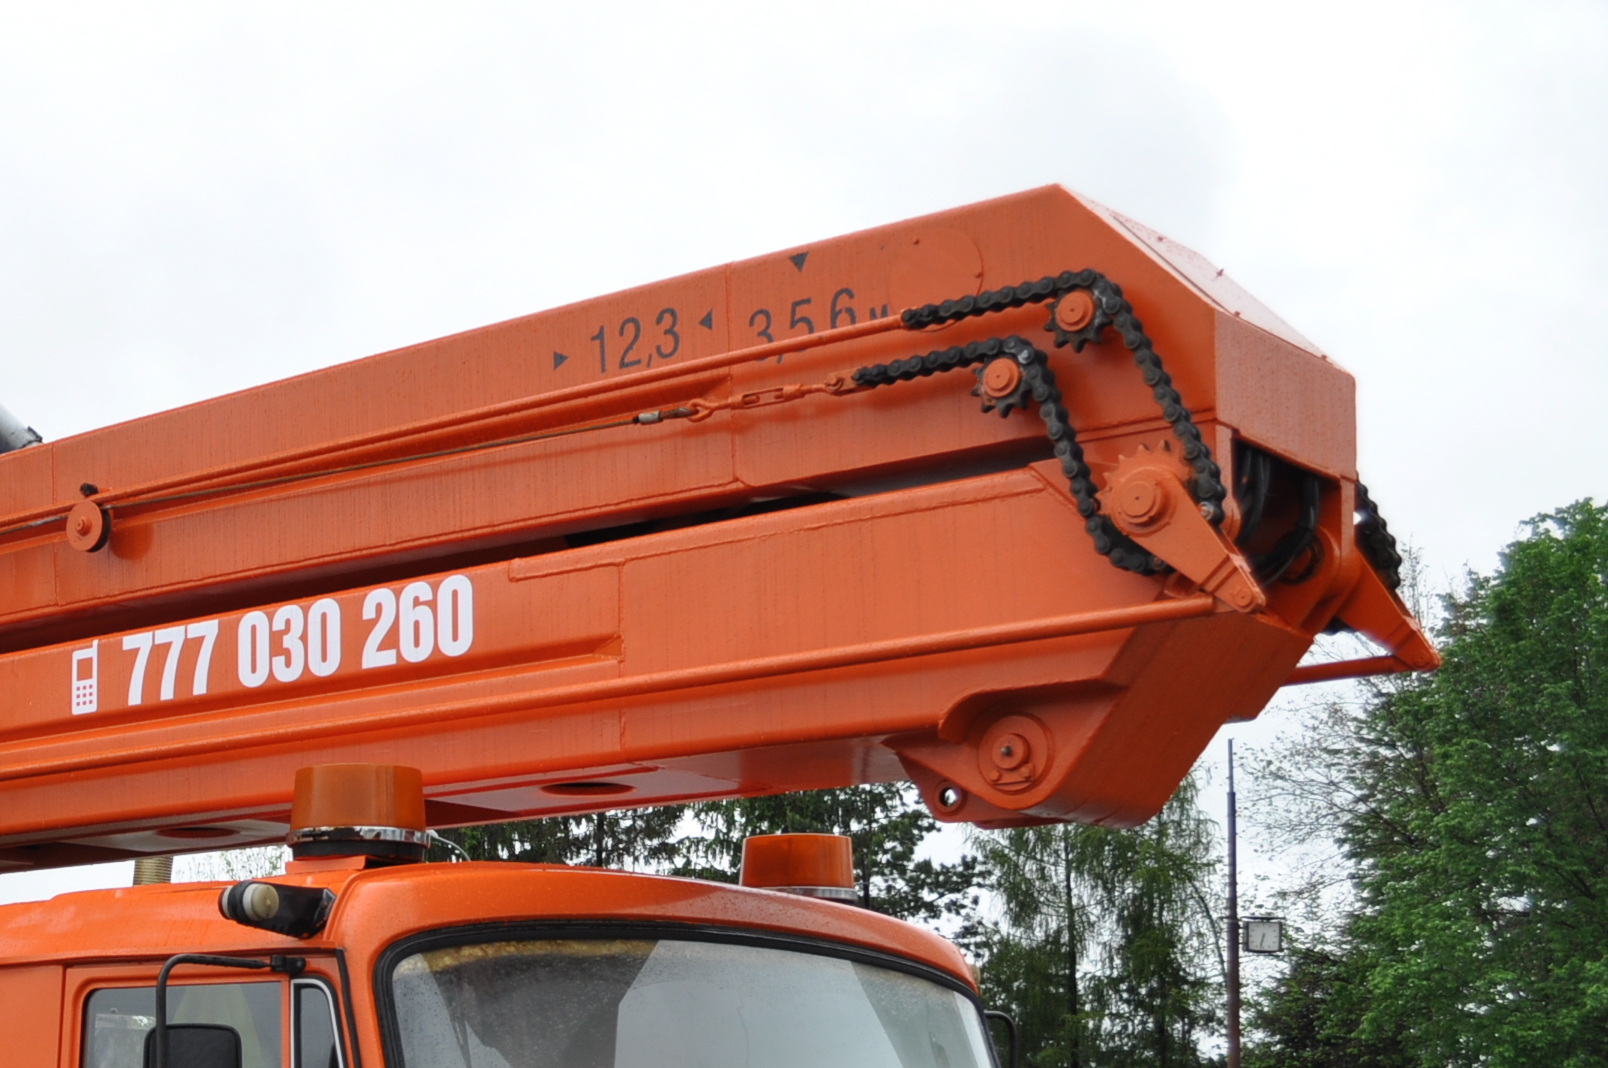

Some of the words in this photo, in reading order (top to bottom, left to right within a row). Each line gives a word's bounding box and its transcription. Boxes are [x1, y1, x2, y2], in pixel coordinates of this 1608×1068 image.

[590, 307, 681, 374] 12,3
[122, 619, 219, 707] 777
[237, 597, 341, 688] 030
[361, 574, 474, 670] 260
